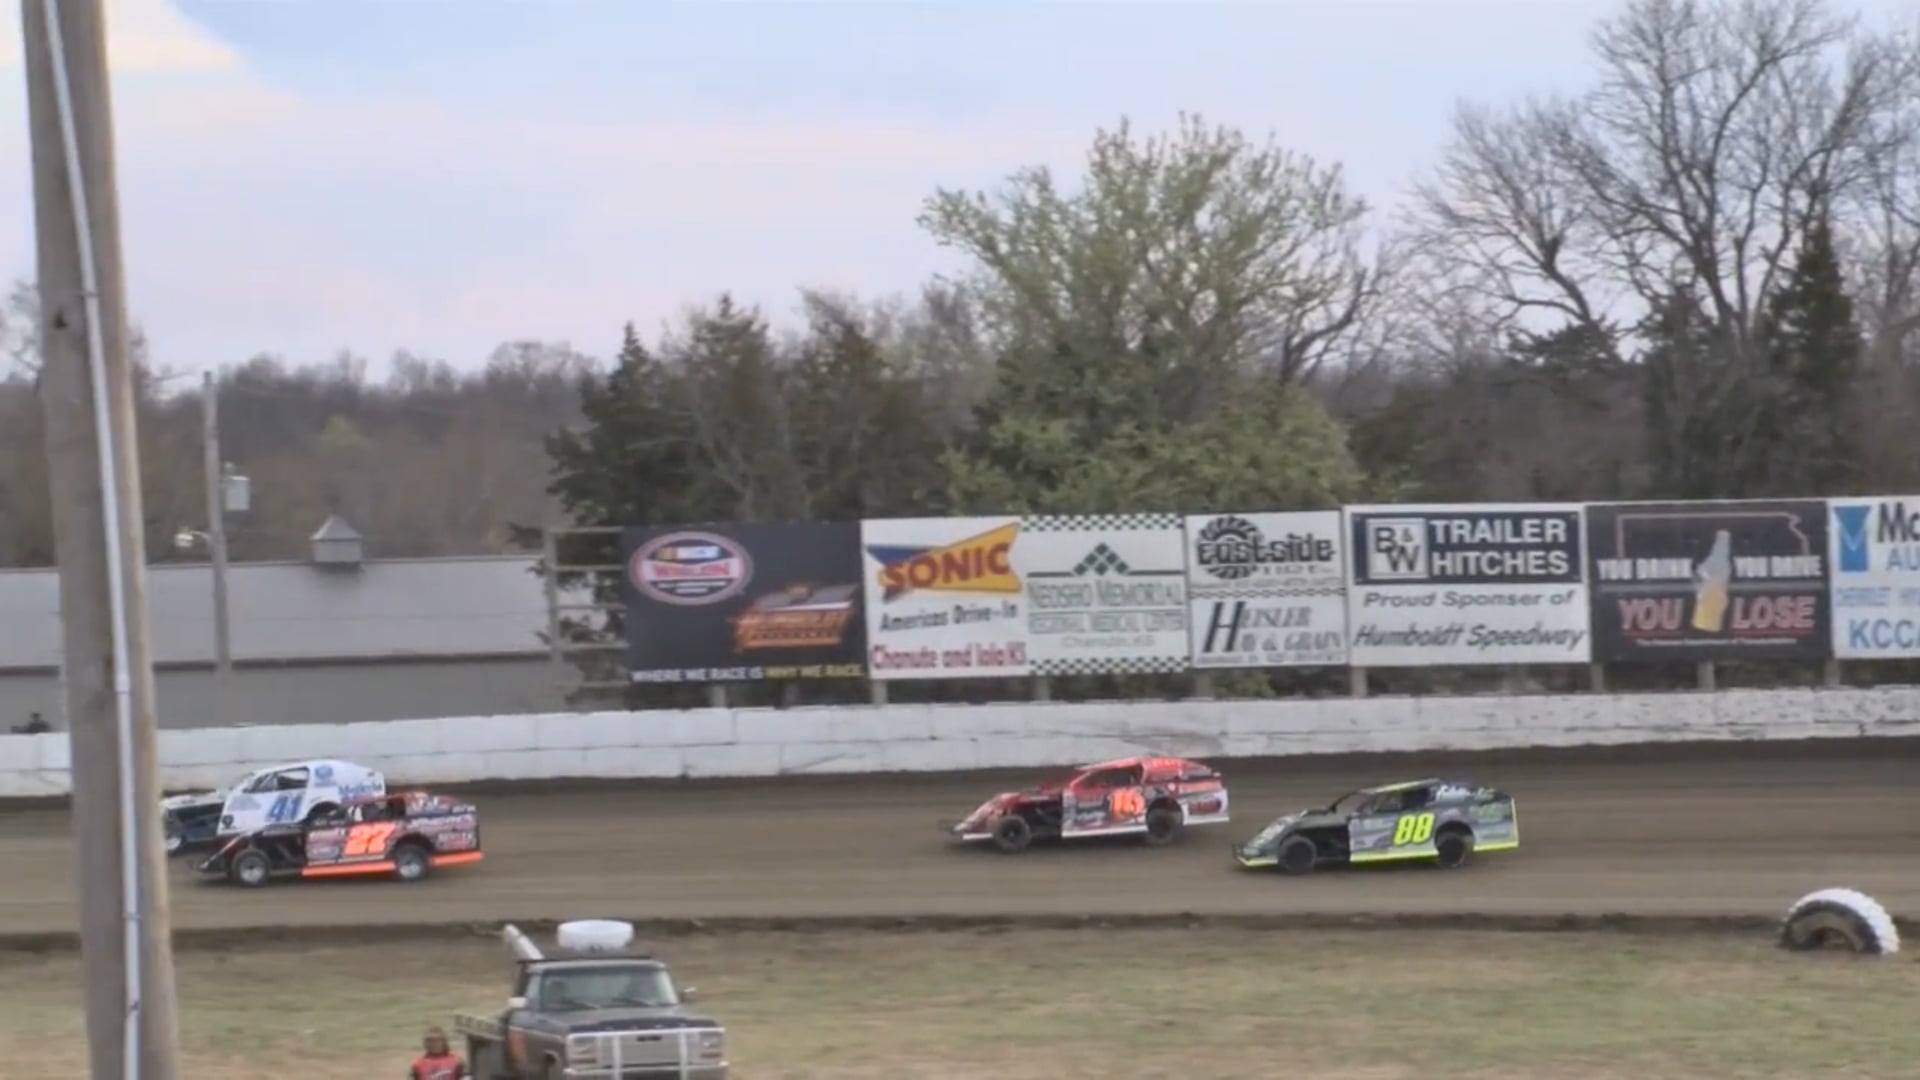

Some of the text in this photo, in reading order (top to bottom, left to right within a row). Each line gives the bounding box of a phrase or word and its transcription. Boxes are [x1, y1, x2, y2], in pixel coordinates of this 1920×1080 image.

[1430, 519, 1567, 544] TRAILER
[884, 543, 1011, 588] SONIC
[1432, 551, 1569, 576] HITCHES
[1364, 592, 1435, 608] Proud
[1549, 589, 1575, 606] of
[1619, 598, 1684, 631] YOU
[1731, 595, 1817, 629] LOSE
[1353, 624, 1584, 651] Humboldt Speedway
[632, 670, 682, 683] WHERE
[686, 669, 706, 682] WE
[710, 668, 746, 681] RACE
[749, 667, 763, 680] IS
[800, 666, 822, 678] WE
[268, 796, 302, 823] 41
[344, 822, 396, 855] 27
[1393, 812, 1435, 846] 88
